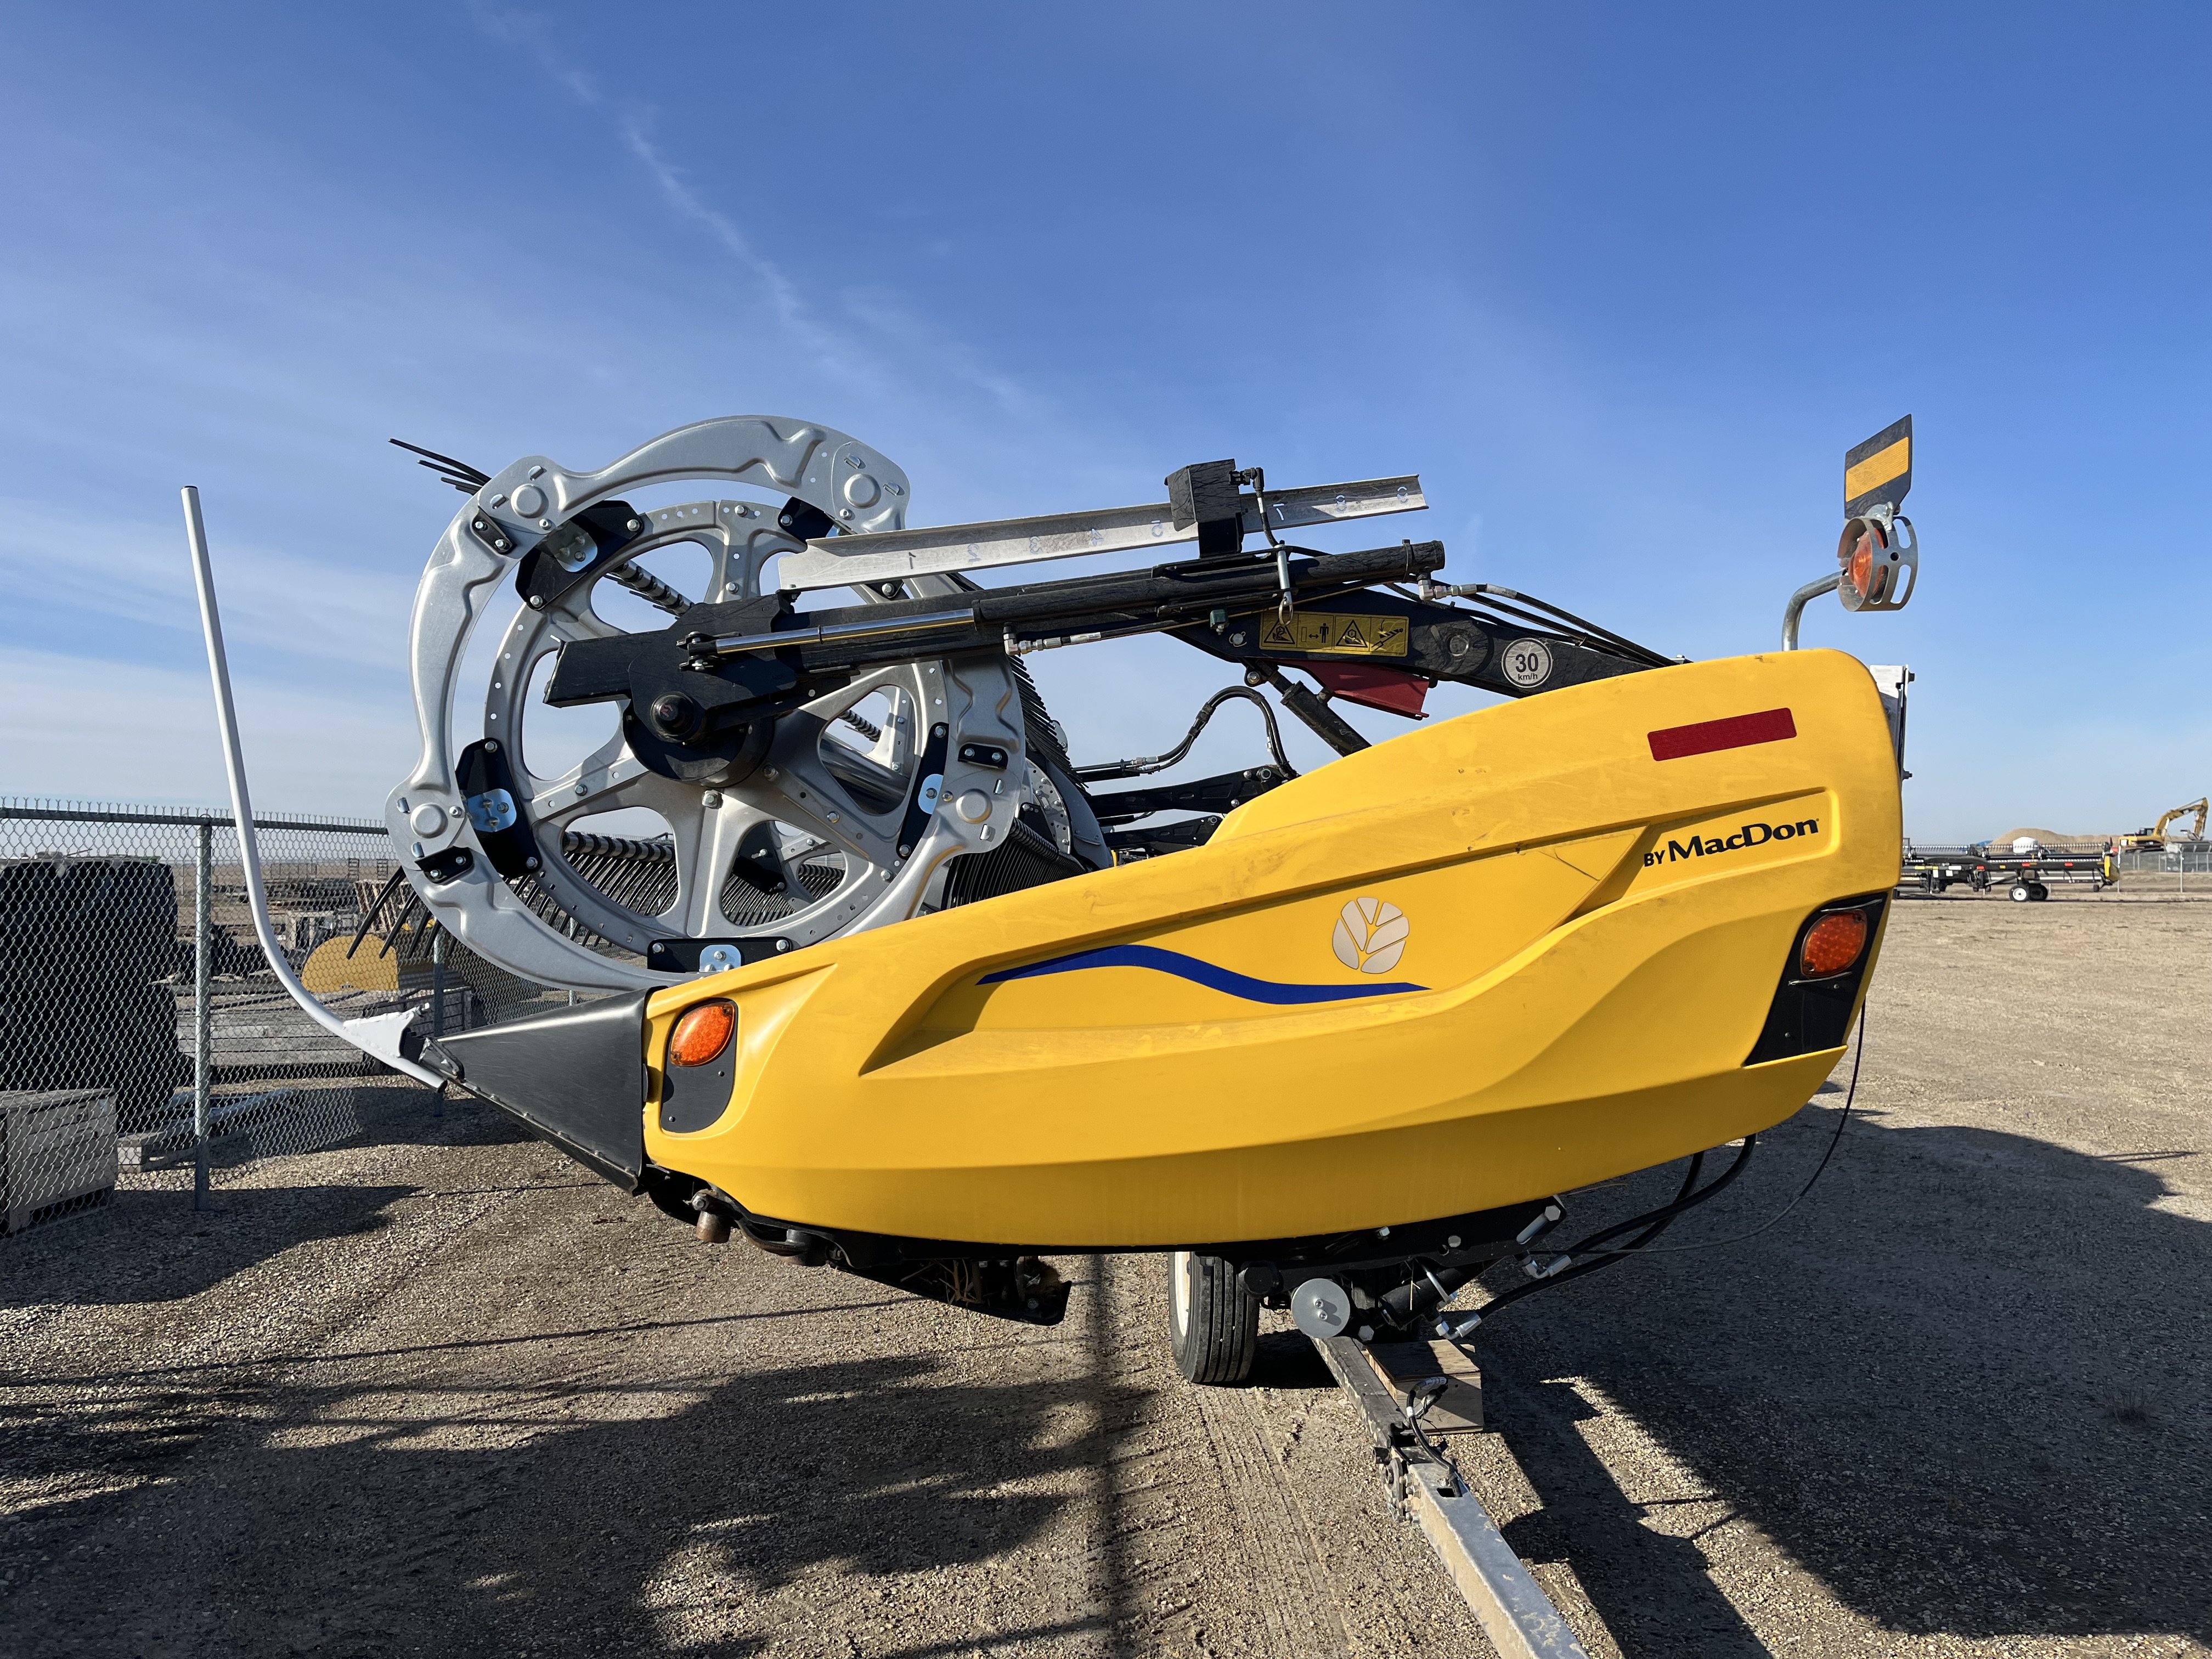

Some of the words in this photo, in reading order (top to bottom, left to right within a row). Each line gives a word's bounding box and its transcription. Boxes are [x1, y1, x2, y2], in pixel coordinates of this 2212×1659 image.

[1515, 653, 1538, 673] 30
[1644, 850, 1666, 867] BY
[1668, 818, 1819, 861] MacDon
